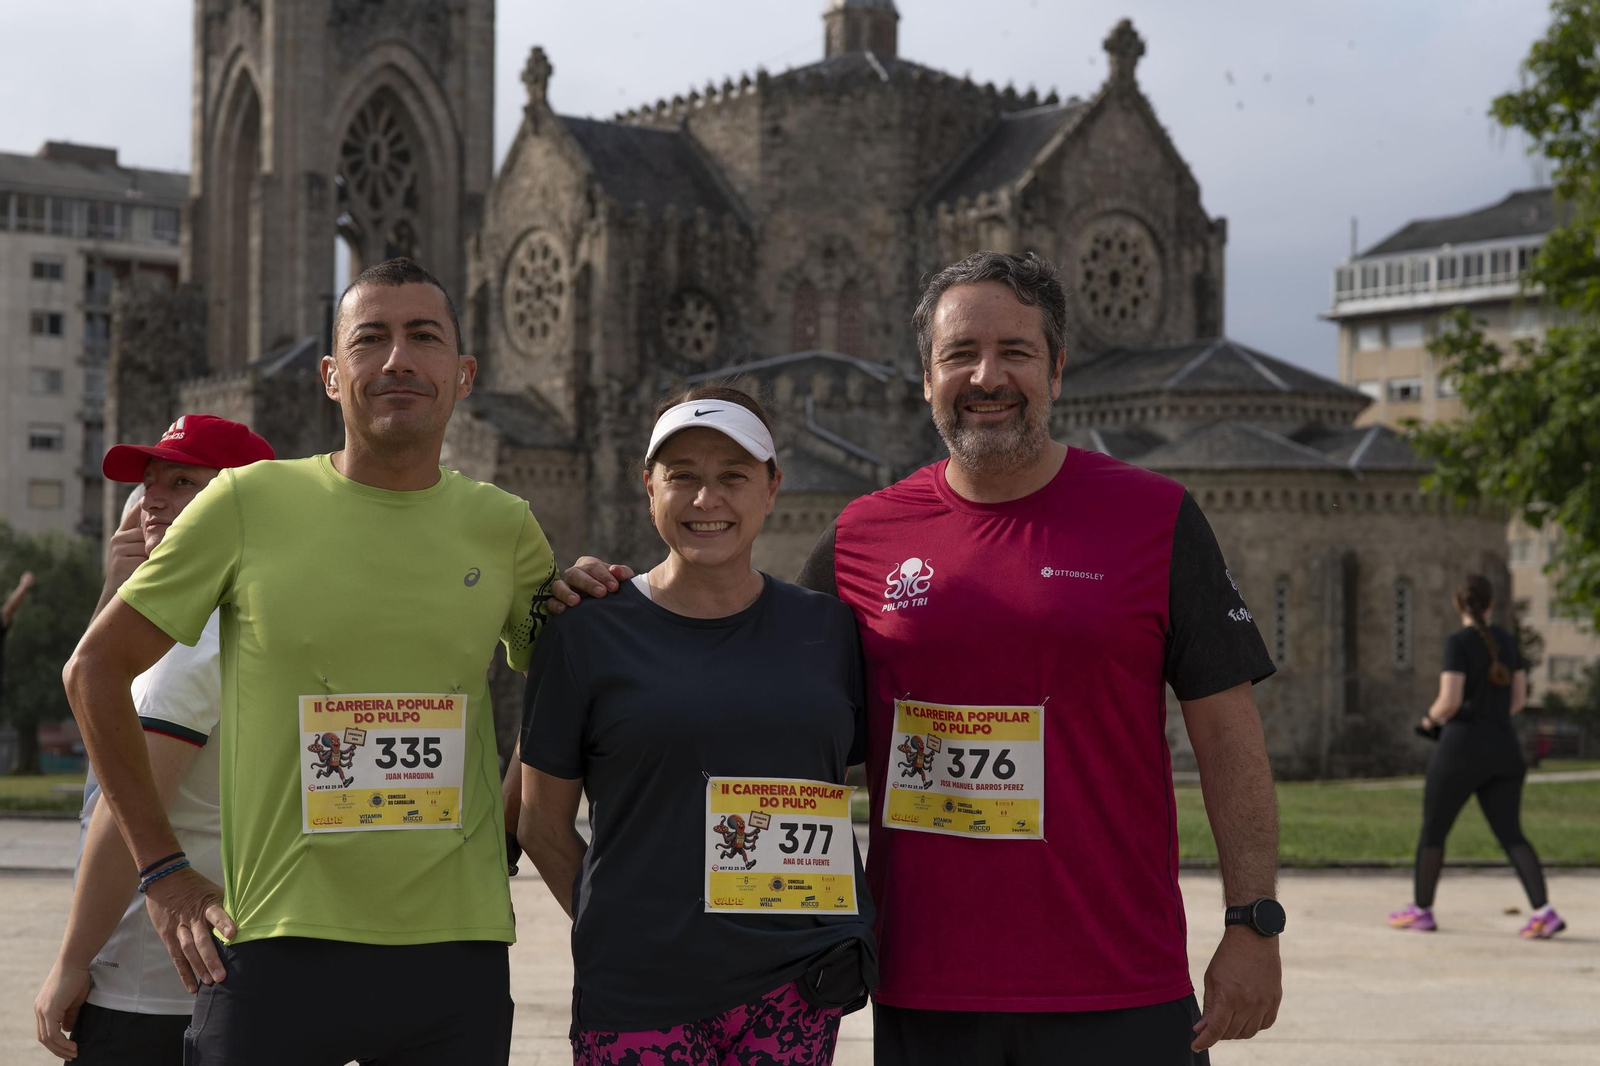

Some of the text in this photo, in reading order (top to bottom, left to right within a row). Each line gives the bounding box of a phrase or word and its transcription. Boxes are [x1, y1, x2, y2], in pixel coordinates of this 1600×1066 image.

[1055, 570, 1104, 580] OTTOBOSLEY
[881, 597, 928, 612] PULPO TRI
[314, 699, 454, 712] II CARREIRA POPULAR
[354, 712, 420, 723] DO PULPO
[906, 706, 1030, 722] II CARREIRA POPULAR
[933, 722, 992, 735] DO PULPO
[375, 737, 442, 769] 335
[947, 747, 1015, 780] 376
[941, 779, 951, 788] JOSE
[952, 781, 974, 790] MANUEL
[722, 784, 844, 799] II CARREIRA POPULAR
[760, 797, 817, 809] DO PULPO
[313, 817, 343, 825] GADIS
[779, 823, 833, 854] 377
[714, 897, 744, 905] GADIS
